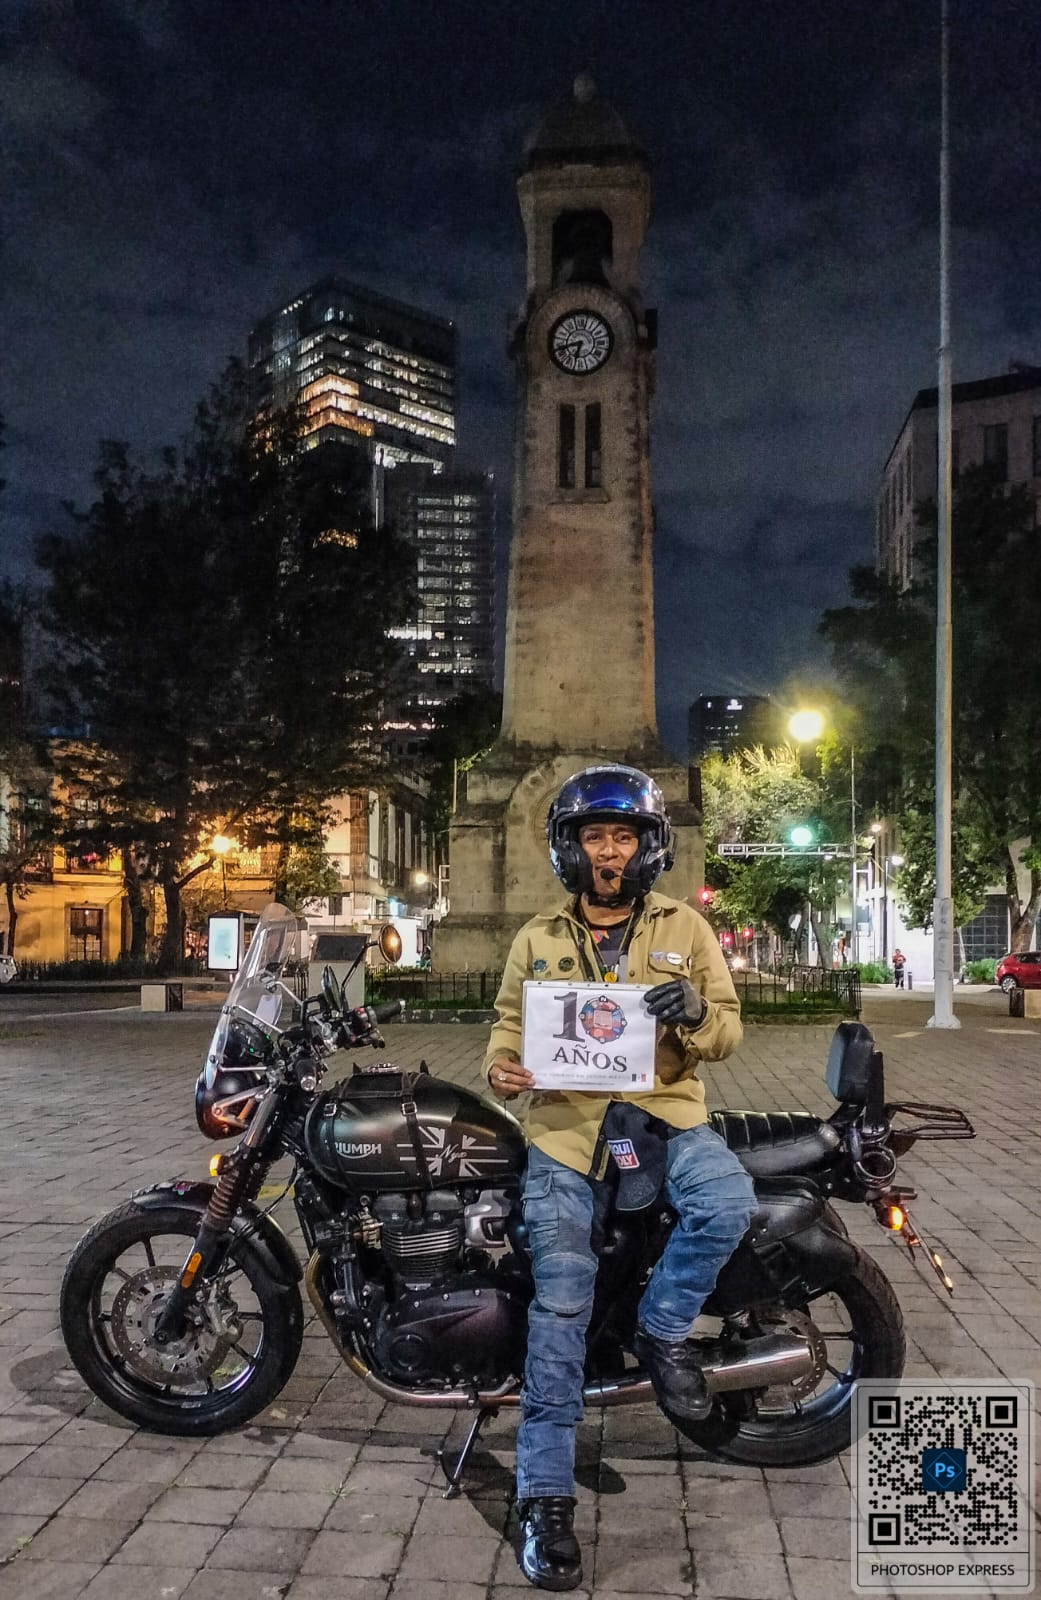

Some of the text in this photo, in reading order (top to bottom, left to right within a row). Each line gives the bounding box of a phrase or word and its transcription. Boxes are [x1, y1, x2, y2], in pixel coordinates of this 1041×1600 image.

[552, 1044, 628, 1073] AÑOS
[328, 1141, 382, 1159] IUMPH
[611, 1142, 631, 1155] QUI
[616, 1154, 633, 1166] OLY
